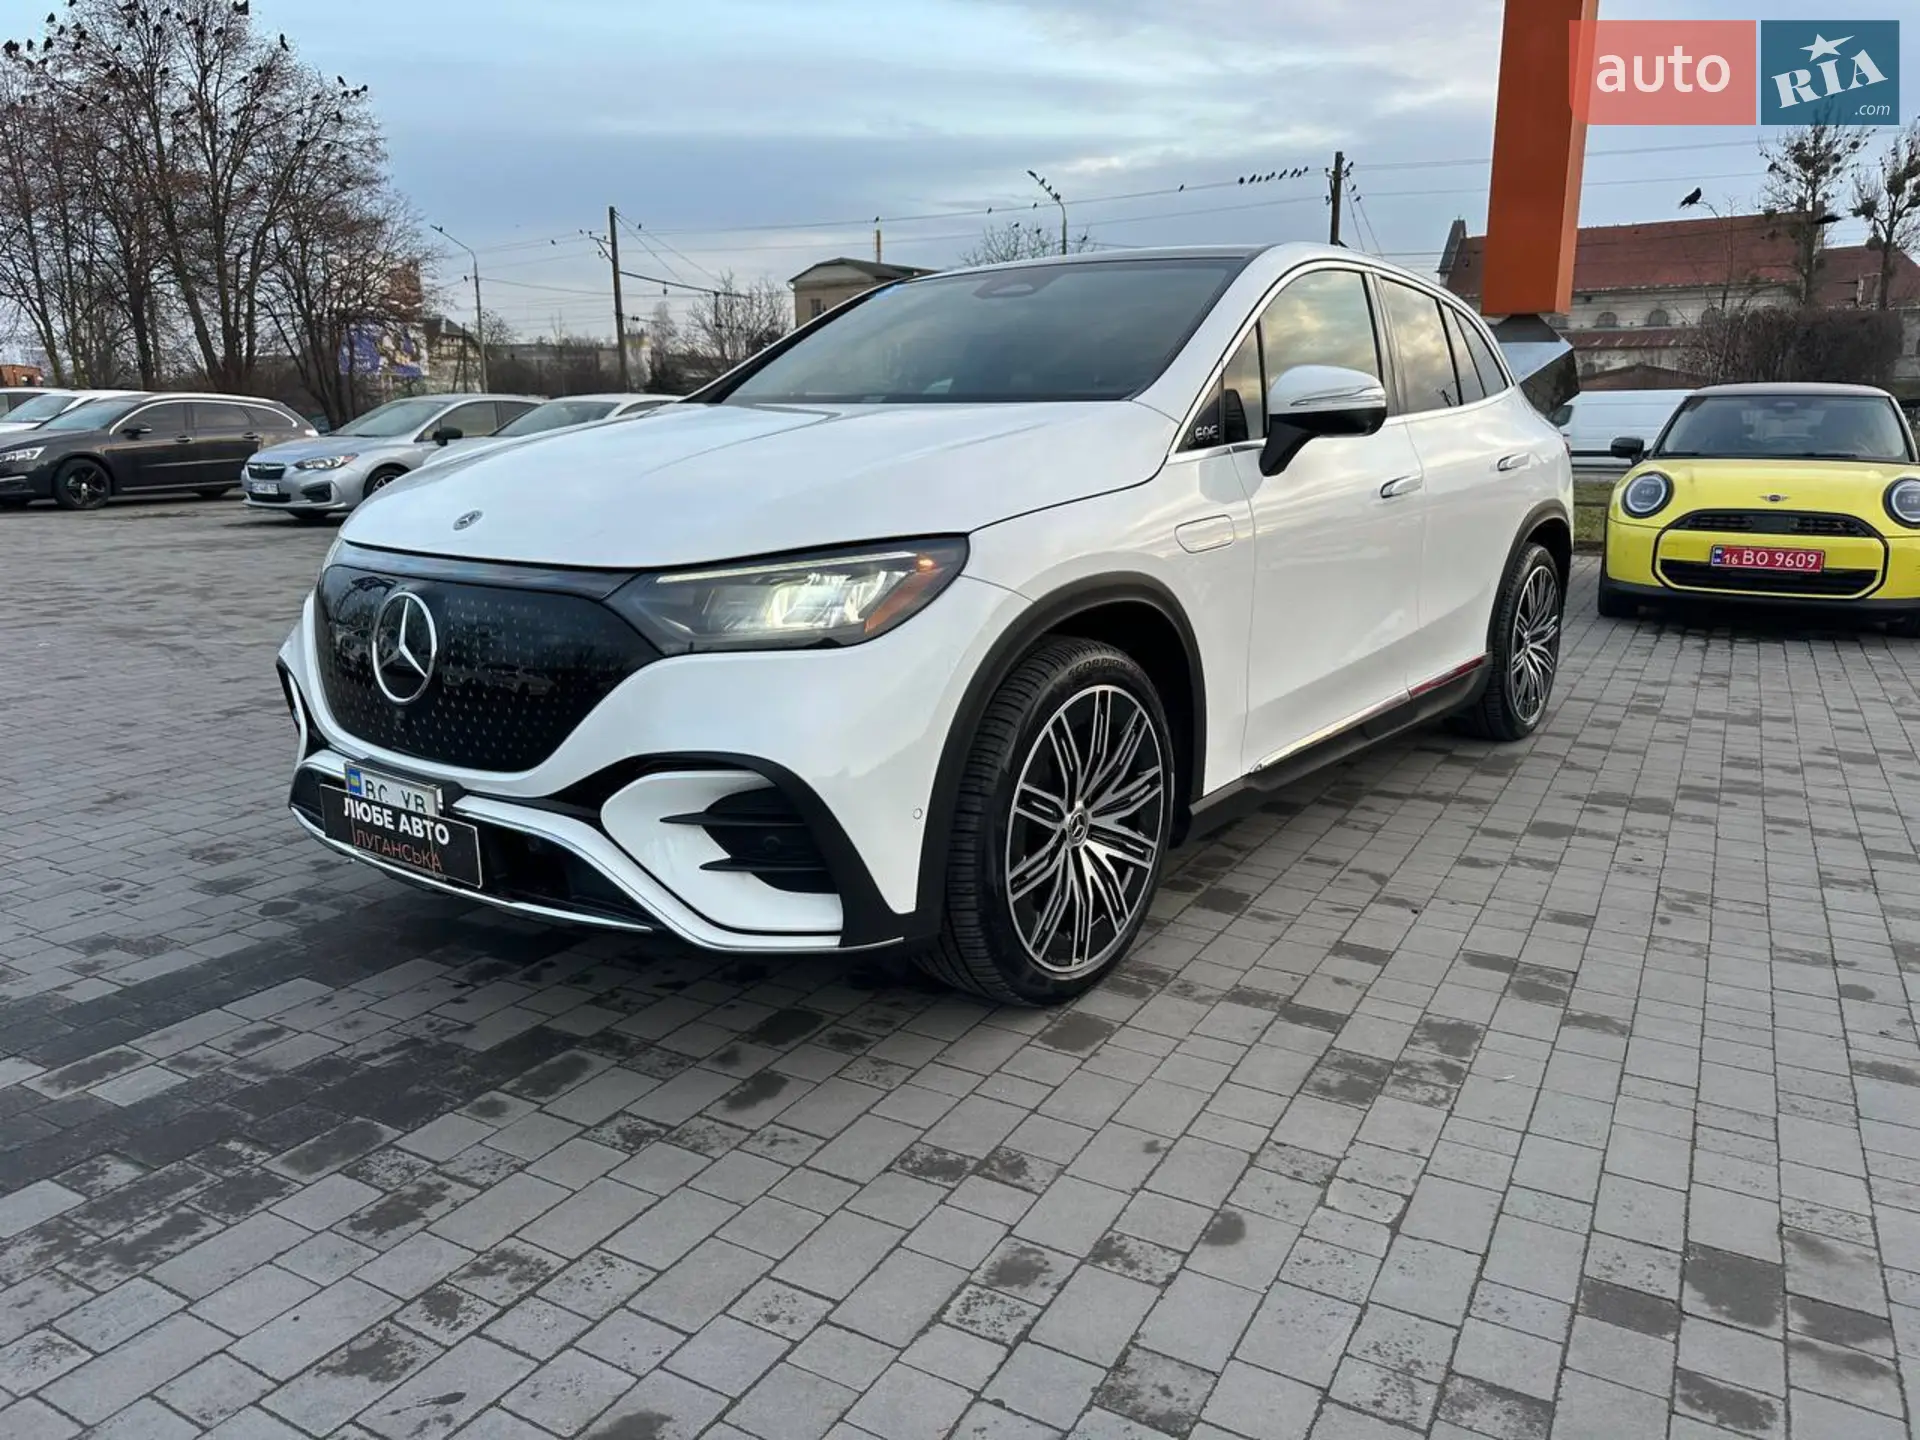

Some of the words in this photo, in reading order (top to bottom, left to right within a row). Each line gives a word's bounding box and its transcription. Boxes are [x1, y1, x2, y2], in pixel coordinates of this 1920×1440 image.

[1723, 553, 1738, 565] 16
[1742, 550, 1769, 565] BO
[1774, 552, 1817, 568] 9609
[344, 797, 395, 830] ЛЮБЕ
[399, 814, 450, 845] АВТО
[353, 829, 442, 872] ЛУГАНСЬКА
